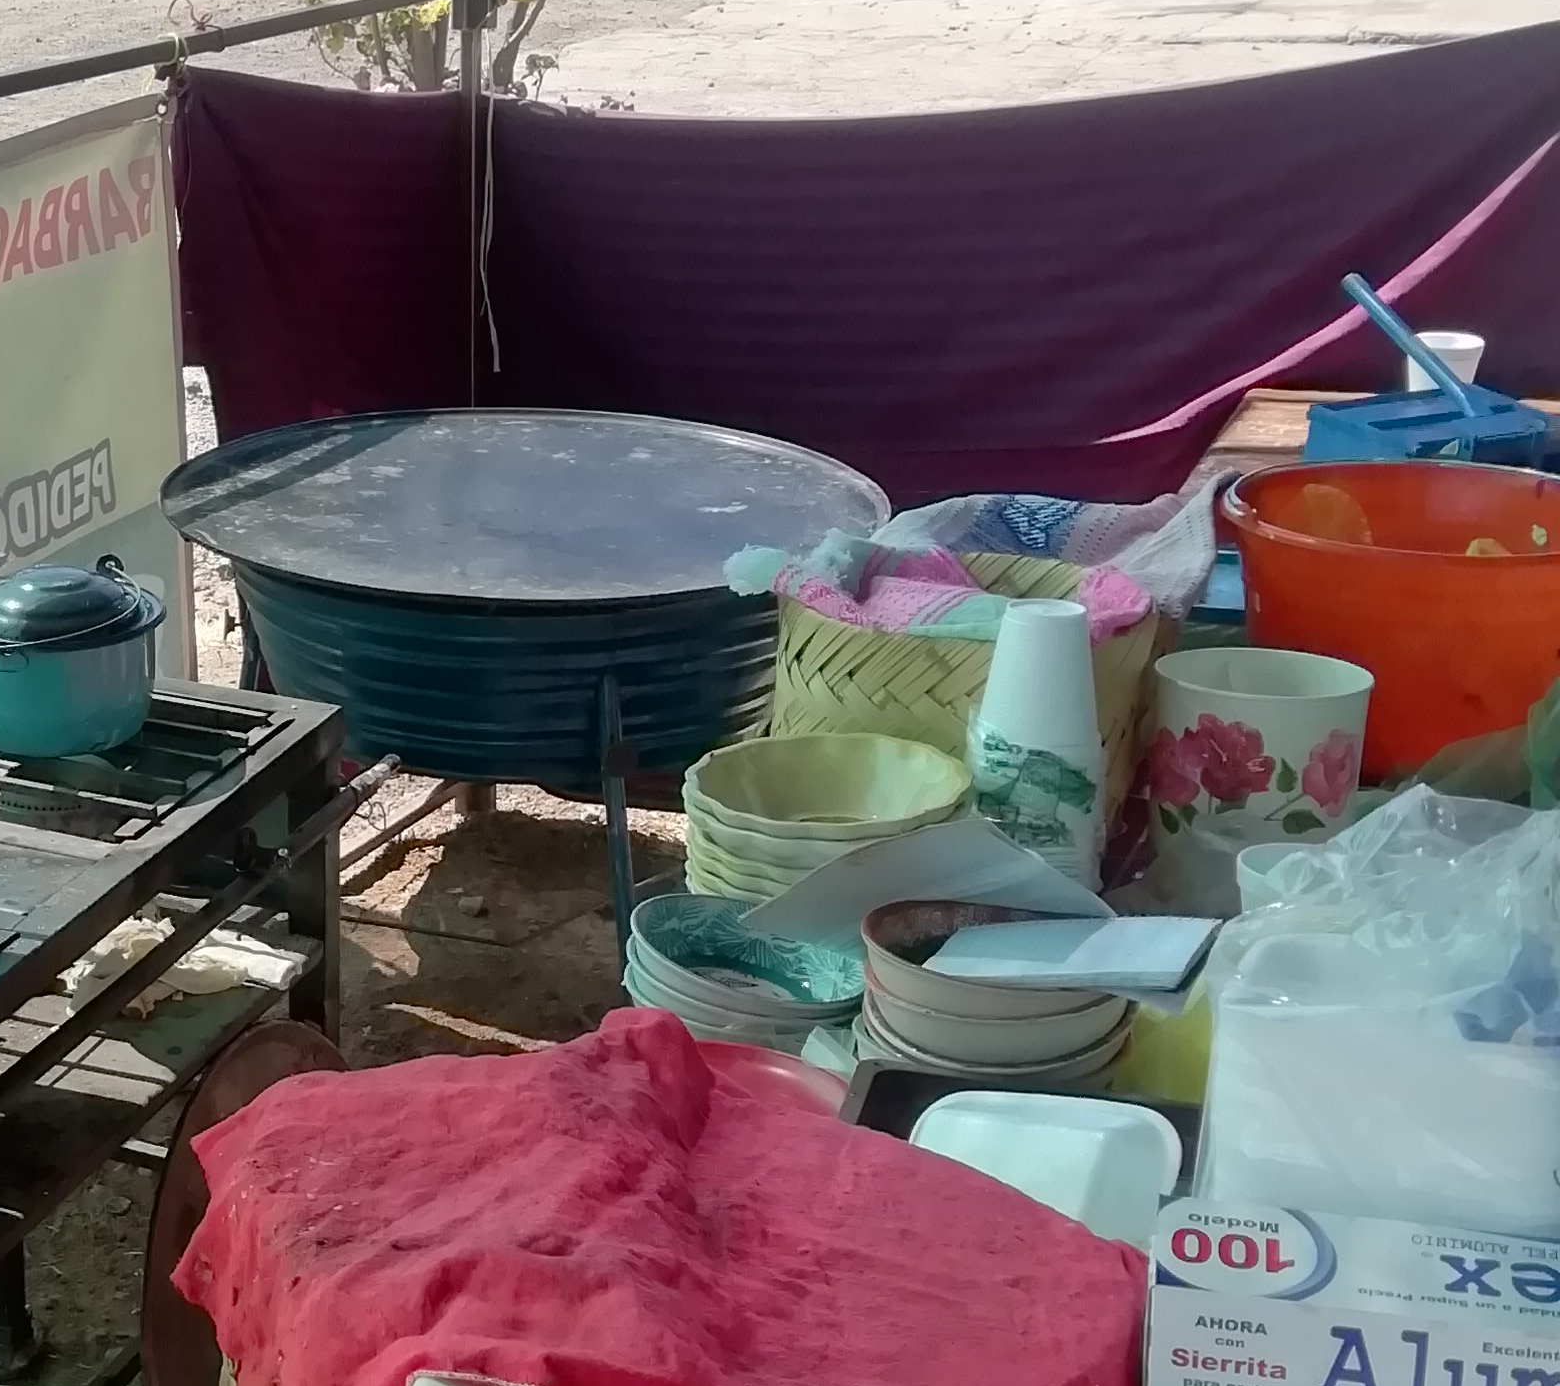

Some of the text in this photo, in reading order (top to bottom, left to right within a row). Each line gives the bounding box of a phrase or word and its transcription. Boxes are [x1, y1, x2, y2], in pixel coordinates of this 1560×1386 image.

[1187, 1213, 1279, 1234] Modelo
[1171, 1227, 1295, 1273] 100
[1411, 1233, 1510, 1255] ALUMINIO
[1357, 1287, 1413, 1302] Precio
[1419, 1295, 1469, 1309] Super
[1475, 1301, 1496, 1311] un
[1195, 1315, 1268, 1336] AHORA
[1215, 1336, 1245, 1349] con
[1171, 1347, 1287, 1380] Sierrita
